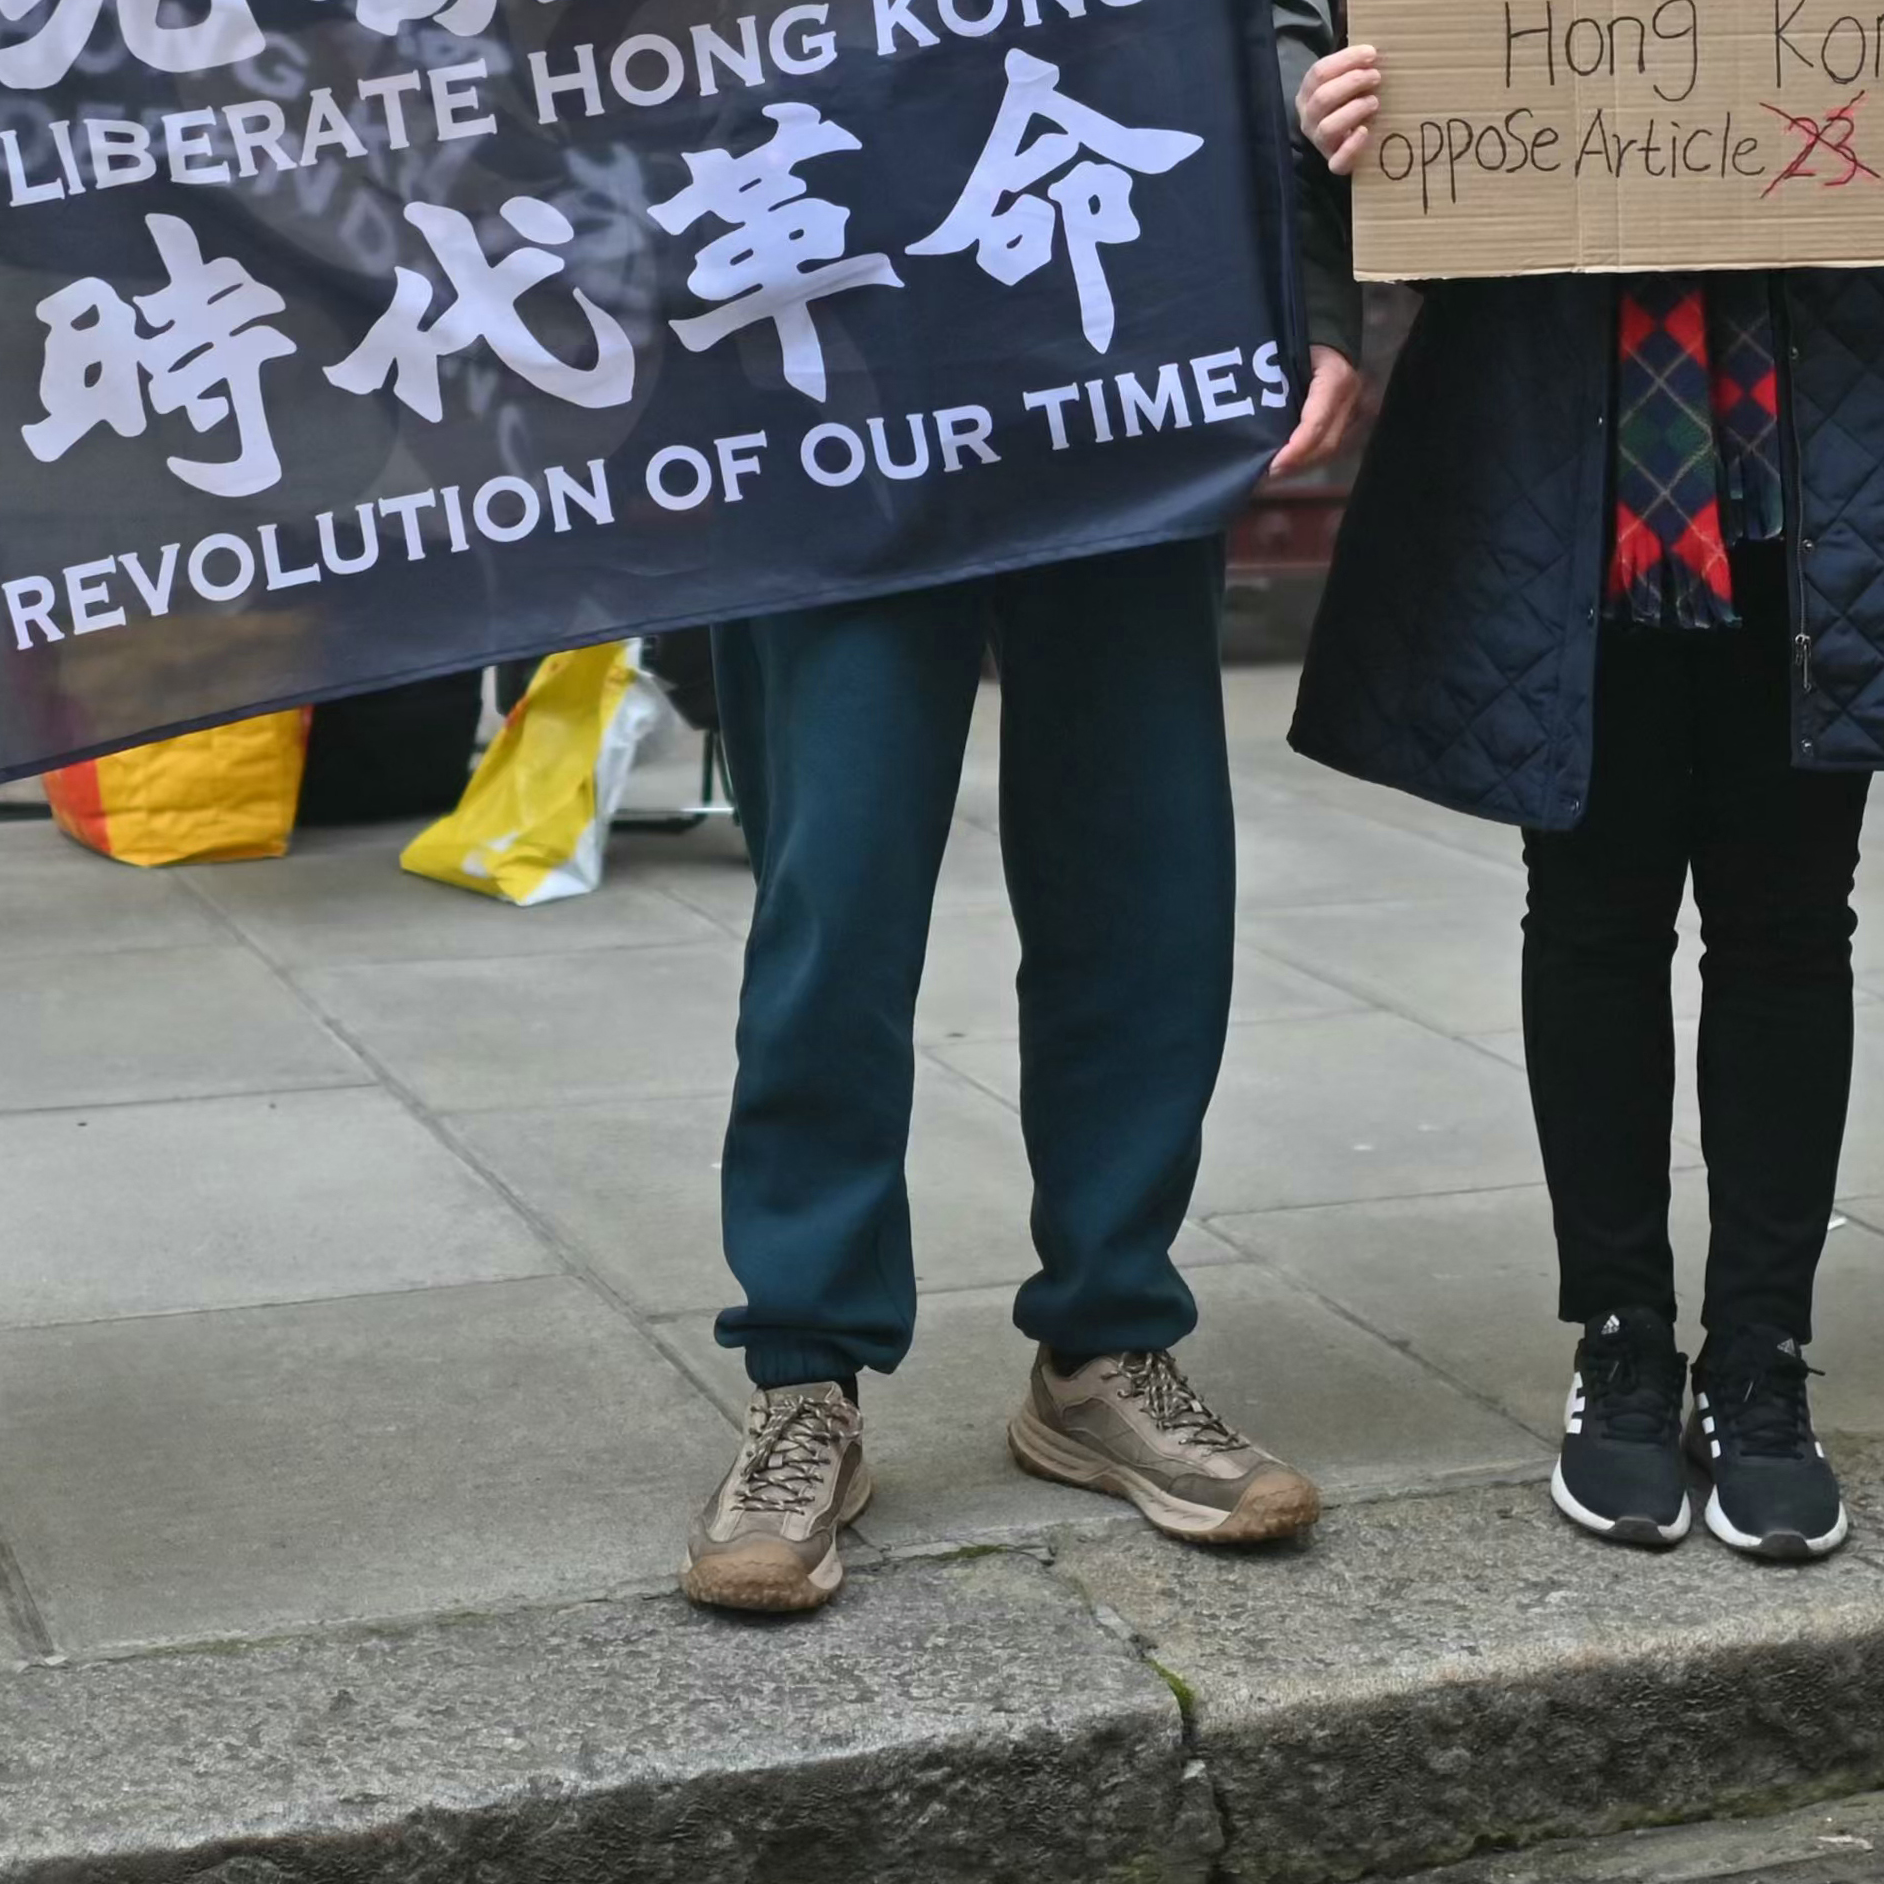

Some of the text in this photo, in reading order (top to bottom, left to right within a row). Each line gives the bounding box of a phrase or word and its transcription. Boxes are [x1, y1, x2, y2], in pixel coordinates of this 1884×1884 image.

[0, 56, 497, 207] LIBERATE
[528, 3, 839, 125] HONG
[1575, 110, 1766, 179] Article
[1781, 114, 1861, 186] 23
[21, 48, 1205, 497] 時代革命
[1, 340, 1289, 651] REVOLUTION OF OUR TIMES
